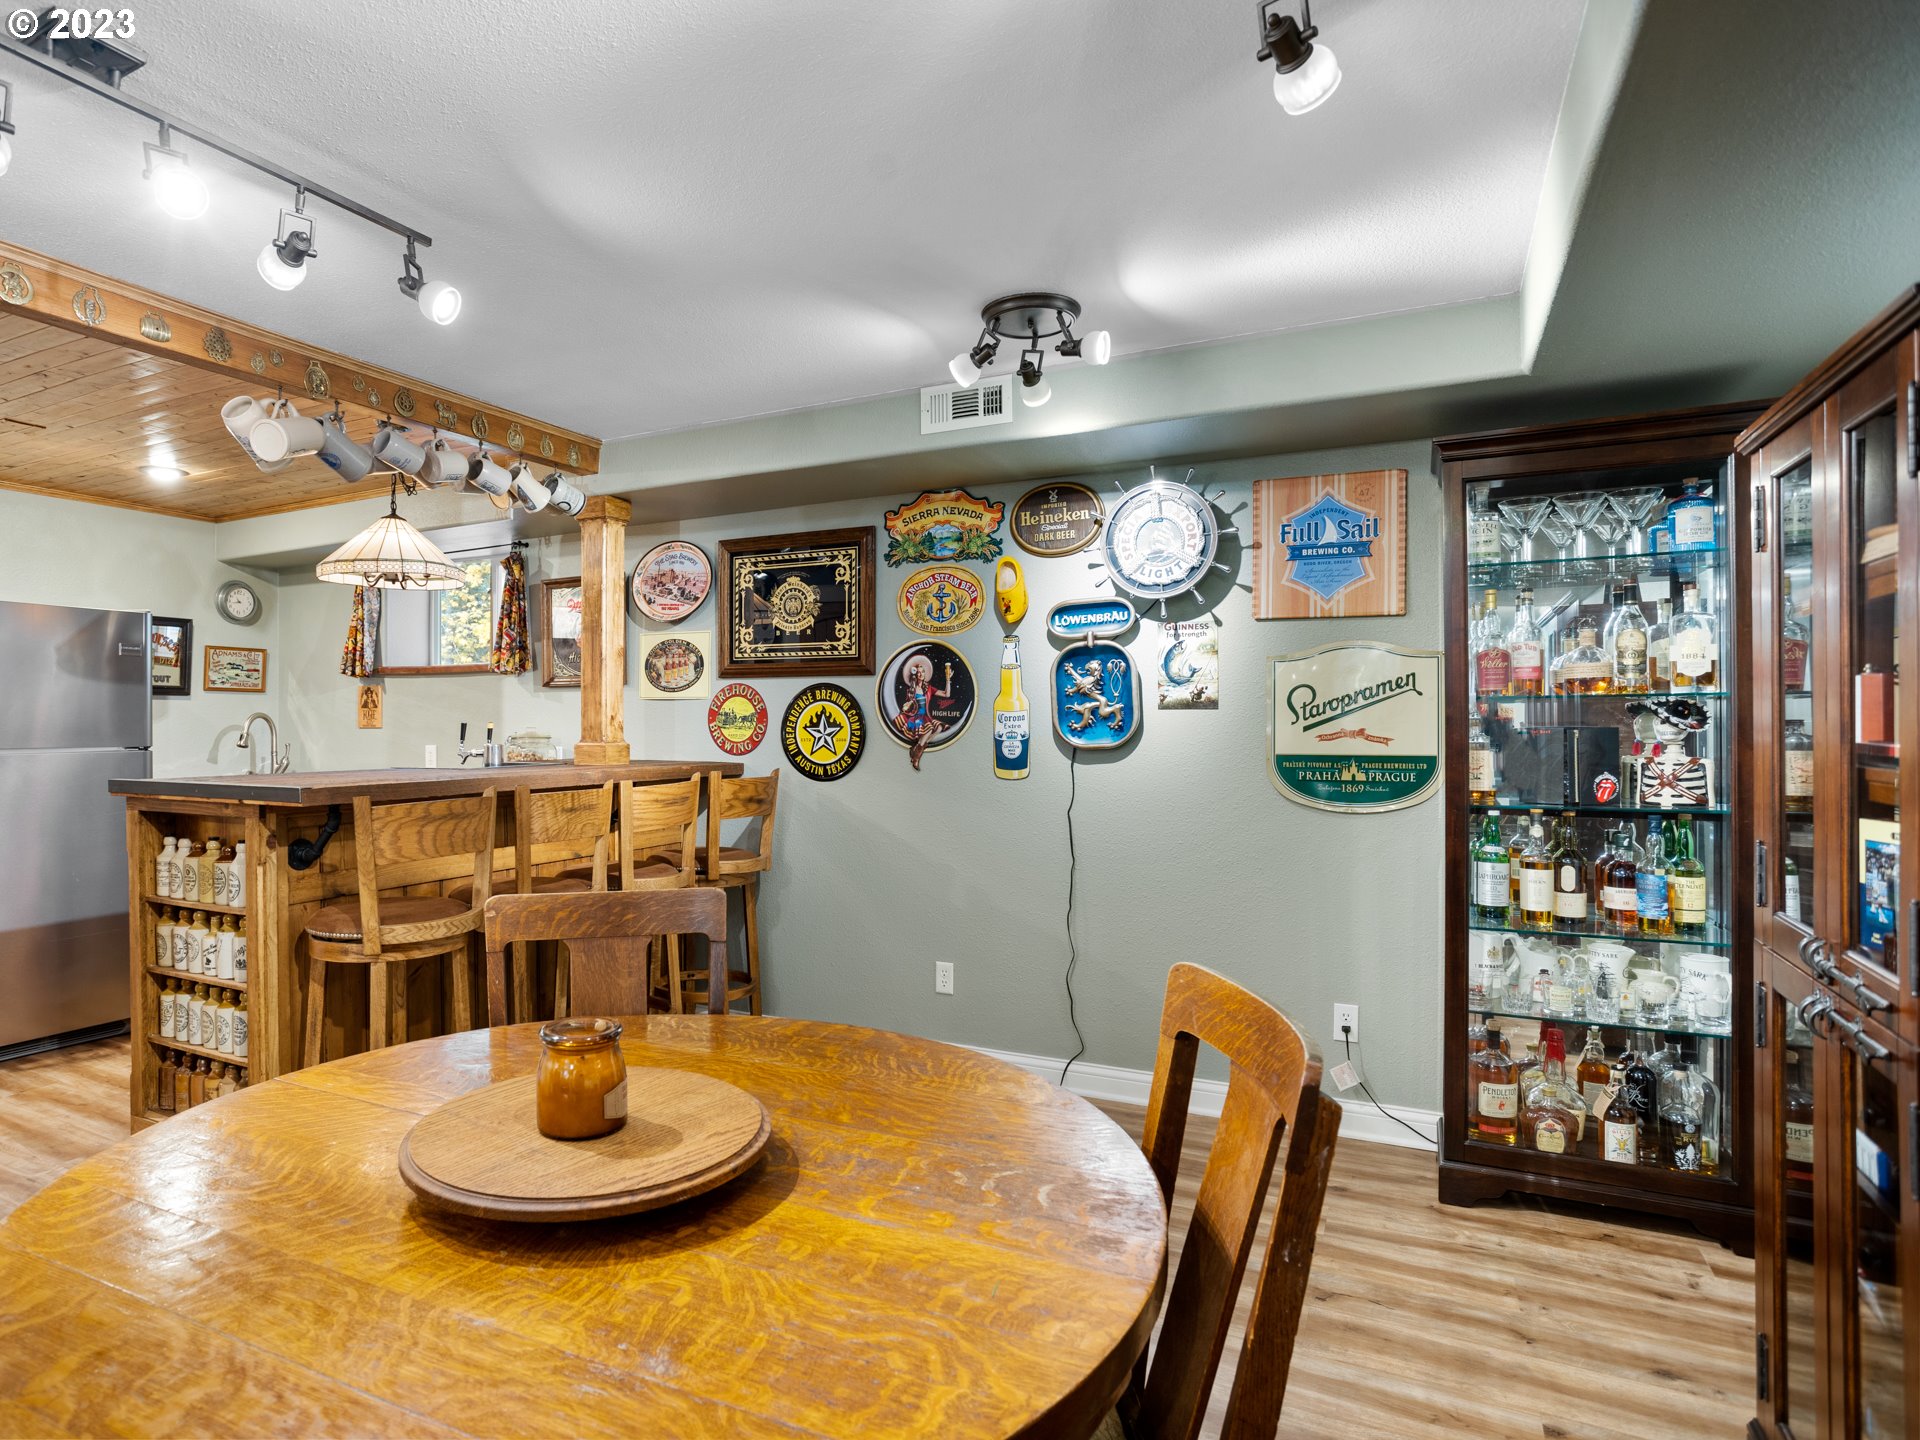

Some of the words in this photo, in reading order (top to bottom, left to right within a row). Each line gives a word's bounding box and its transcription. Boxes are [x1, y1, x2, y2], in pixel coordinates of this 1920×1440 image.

[902, 507, 940, 527] SIERRA
[942, 506, 984, 521] NEVADA
[1020, 507, 1091, 526] Heineken
[1309, 507, 1349, 519] INDEPENDENT
[1041, 522, 1069, 531] Special
[1280, 520, 1320, 544] Full
[1336, 516, 1379, 540] Sail
[1034, 532, 1055, 542] DARK
[1056, 529, 1076, 540] BEER
[1302, 547, 1339, 556] BREWING
[1341, 546, 1356, 554] CO.
[1140, 561, 1183, 578] LIGHT
[907, 576, 935, 600] ANCHOR
[935, 573, 961, 587] STEAM
[961, 582, 979, 599] BEER
[903, 609, 915, 624] Made
[919, 622, 931, 632] San
[930, 624, 956, 632] Francisco
[956, 619, 972, 630] since
[970, 607, 981, 622] 1896
[1055, 610, 1129, 627] LÖWENBRÄU
[775, 628, 812, 637] BEER
[1164, 622, 1210, 631] GUINNESS
[1179, 631, 1208, 639] strength
[211, 649, 243, 661] ADNAMS
[1480, 656, 1509, 669] Weller
[710, 684, 765, 712] FIREHOUSE
[1286, 672, 1423, 726] Staropramen
[785, 692, 814, 755] INDEPENDENCE
[815, 689, 852, 711] BREWING
[847, 709, 861, 756] COMPANY
[997, 713, 1026, 724] Corona
[709, 721, 753, 754] BREWING
[795, 754, 824, 776] AUSTIN
[826, 755, 852, 776] TEXAS
[1368, 772, 1417, 783] PRAGUE
[1341, 783, 1365, 793] 1869
[1688, 968, 1707, 981] SARK
[1482, 1086, 1517, 1097] PENDLETON
